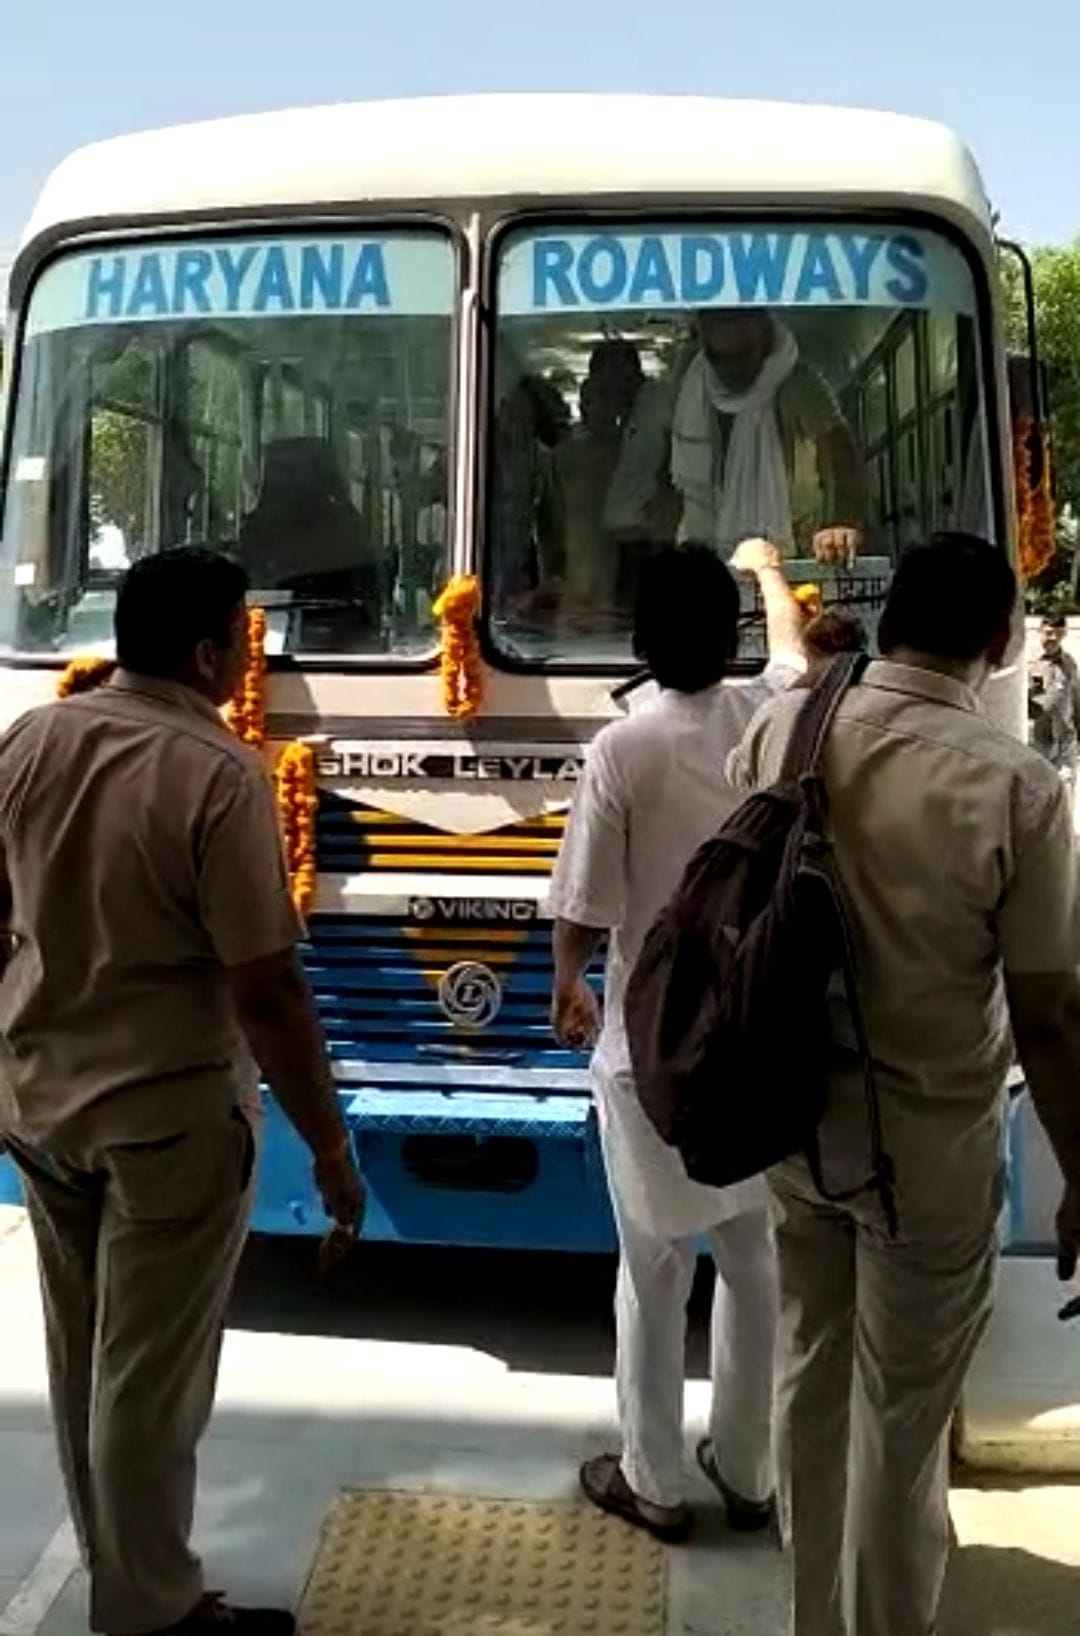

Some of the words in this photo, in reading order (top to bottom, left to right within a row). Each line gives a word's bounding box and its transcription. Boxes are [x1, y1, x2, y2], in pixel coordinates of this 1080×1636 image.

[87, 241, 391, 317] HARYANA
[532, 233, 928, 305] ROADWAYS
[318, 752, 427, 777] SHOK
[454, 756, 585, 780] LEYLA
